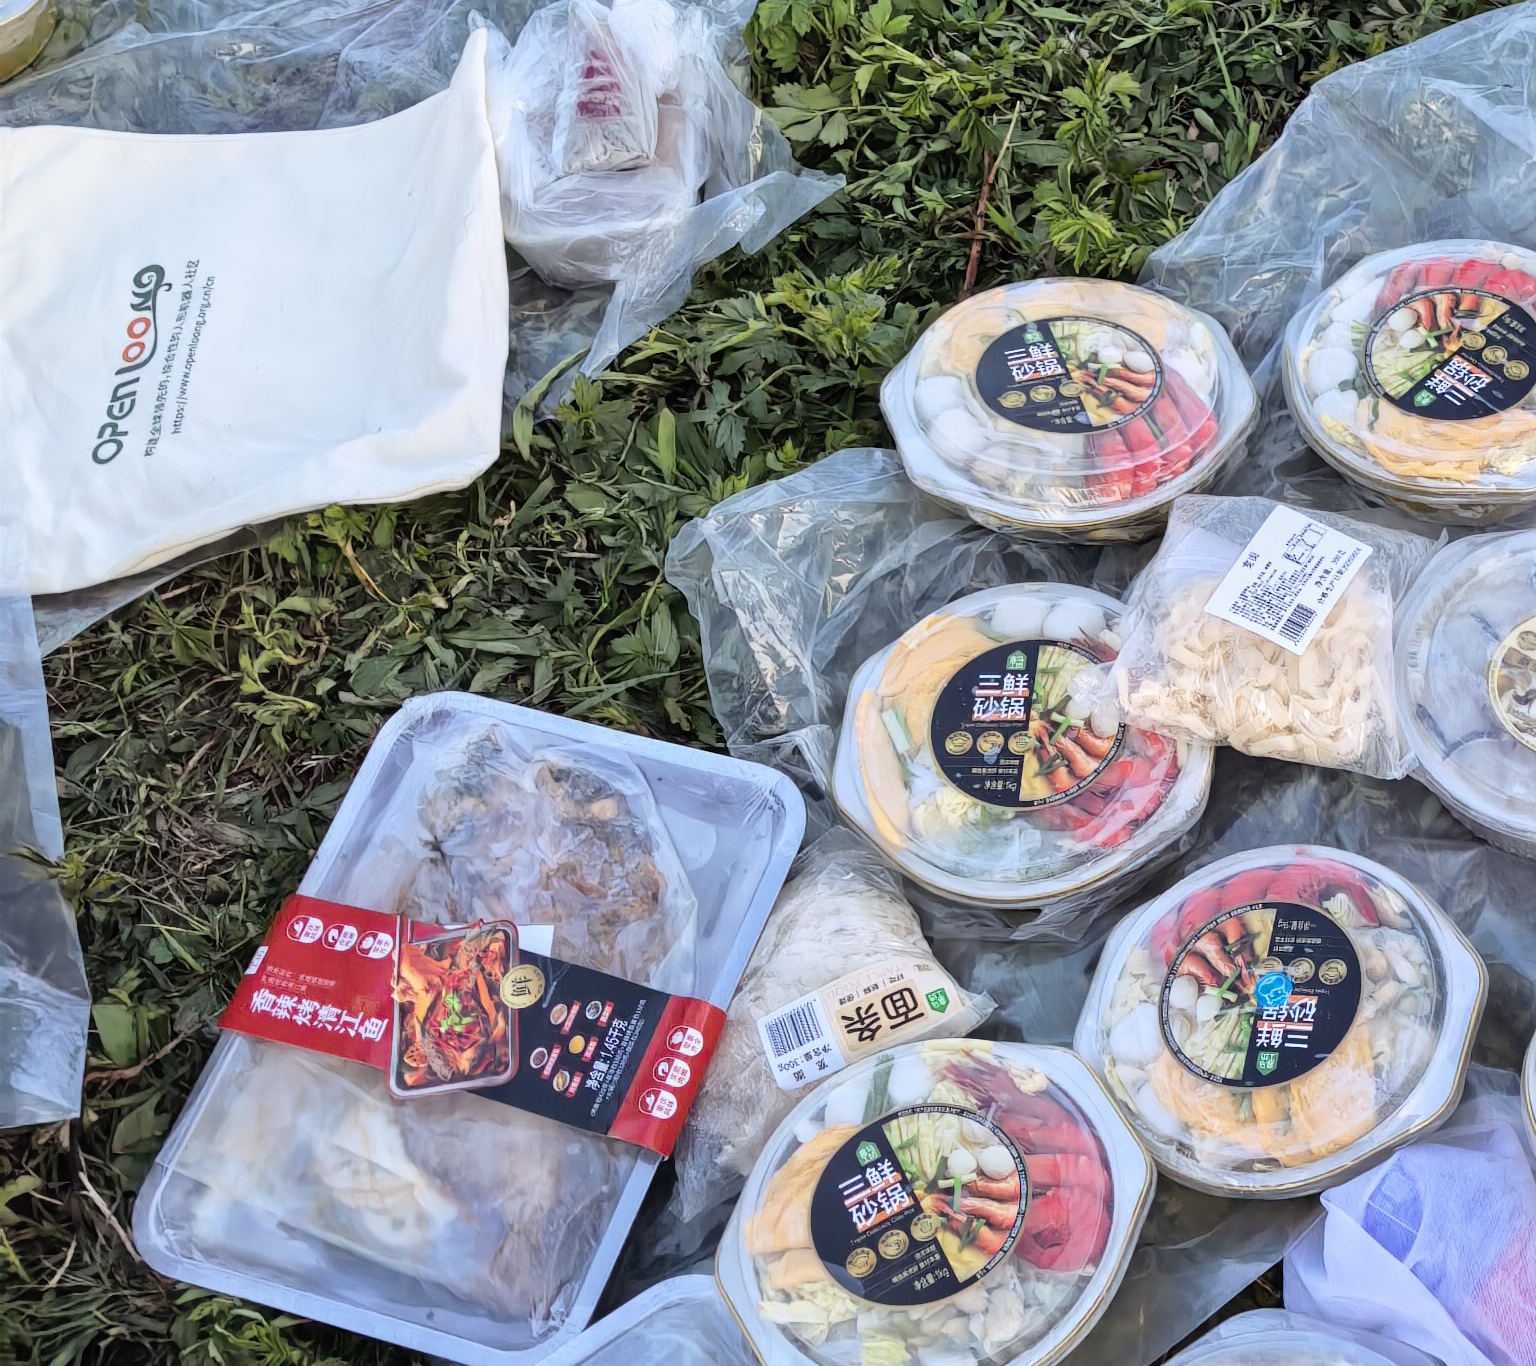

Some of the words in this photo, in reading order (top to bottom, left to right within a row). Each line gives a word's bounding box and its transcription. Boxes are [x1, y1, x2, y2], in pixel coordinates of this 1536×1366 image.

[1004, 342, 1053, 364] 三鲜
[1010, 359, 1061, 381] 砂锅
[1443, 359, 1487, 392] 砂锅
[1425, 371, 1474, 405] 三鲜
[975, 672, 1029, 695] 三鲜
[973, 696, 1025, 719] 砂锅
[836, 984, 927, 1048] 面条
[1254, 1018, 1314, 1051] 三鲜
[837, 1158, 901, 1205] 三鲜
[849, 1182, 910, 1231] 砂锅
